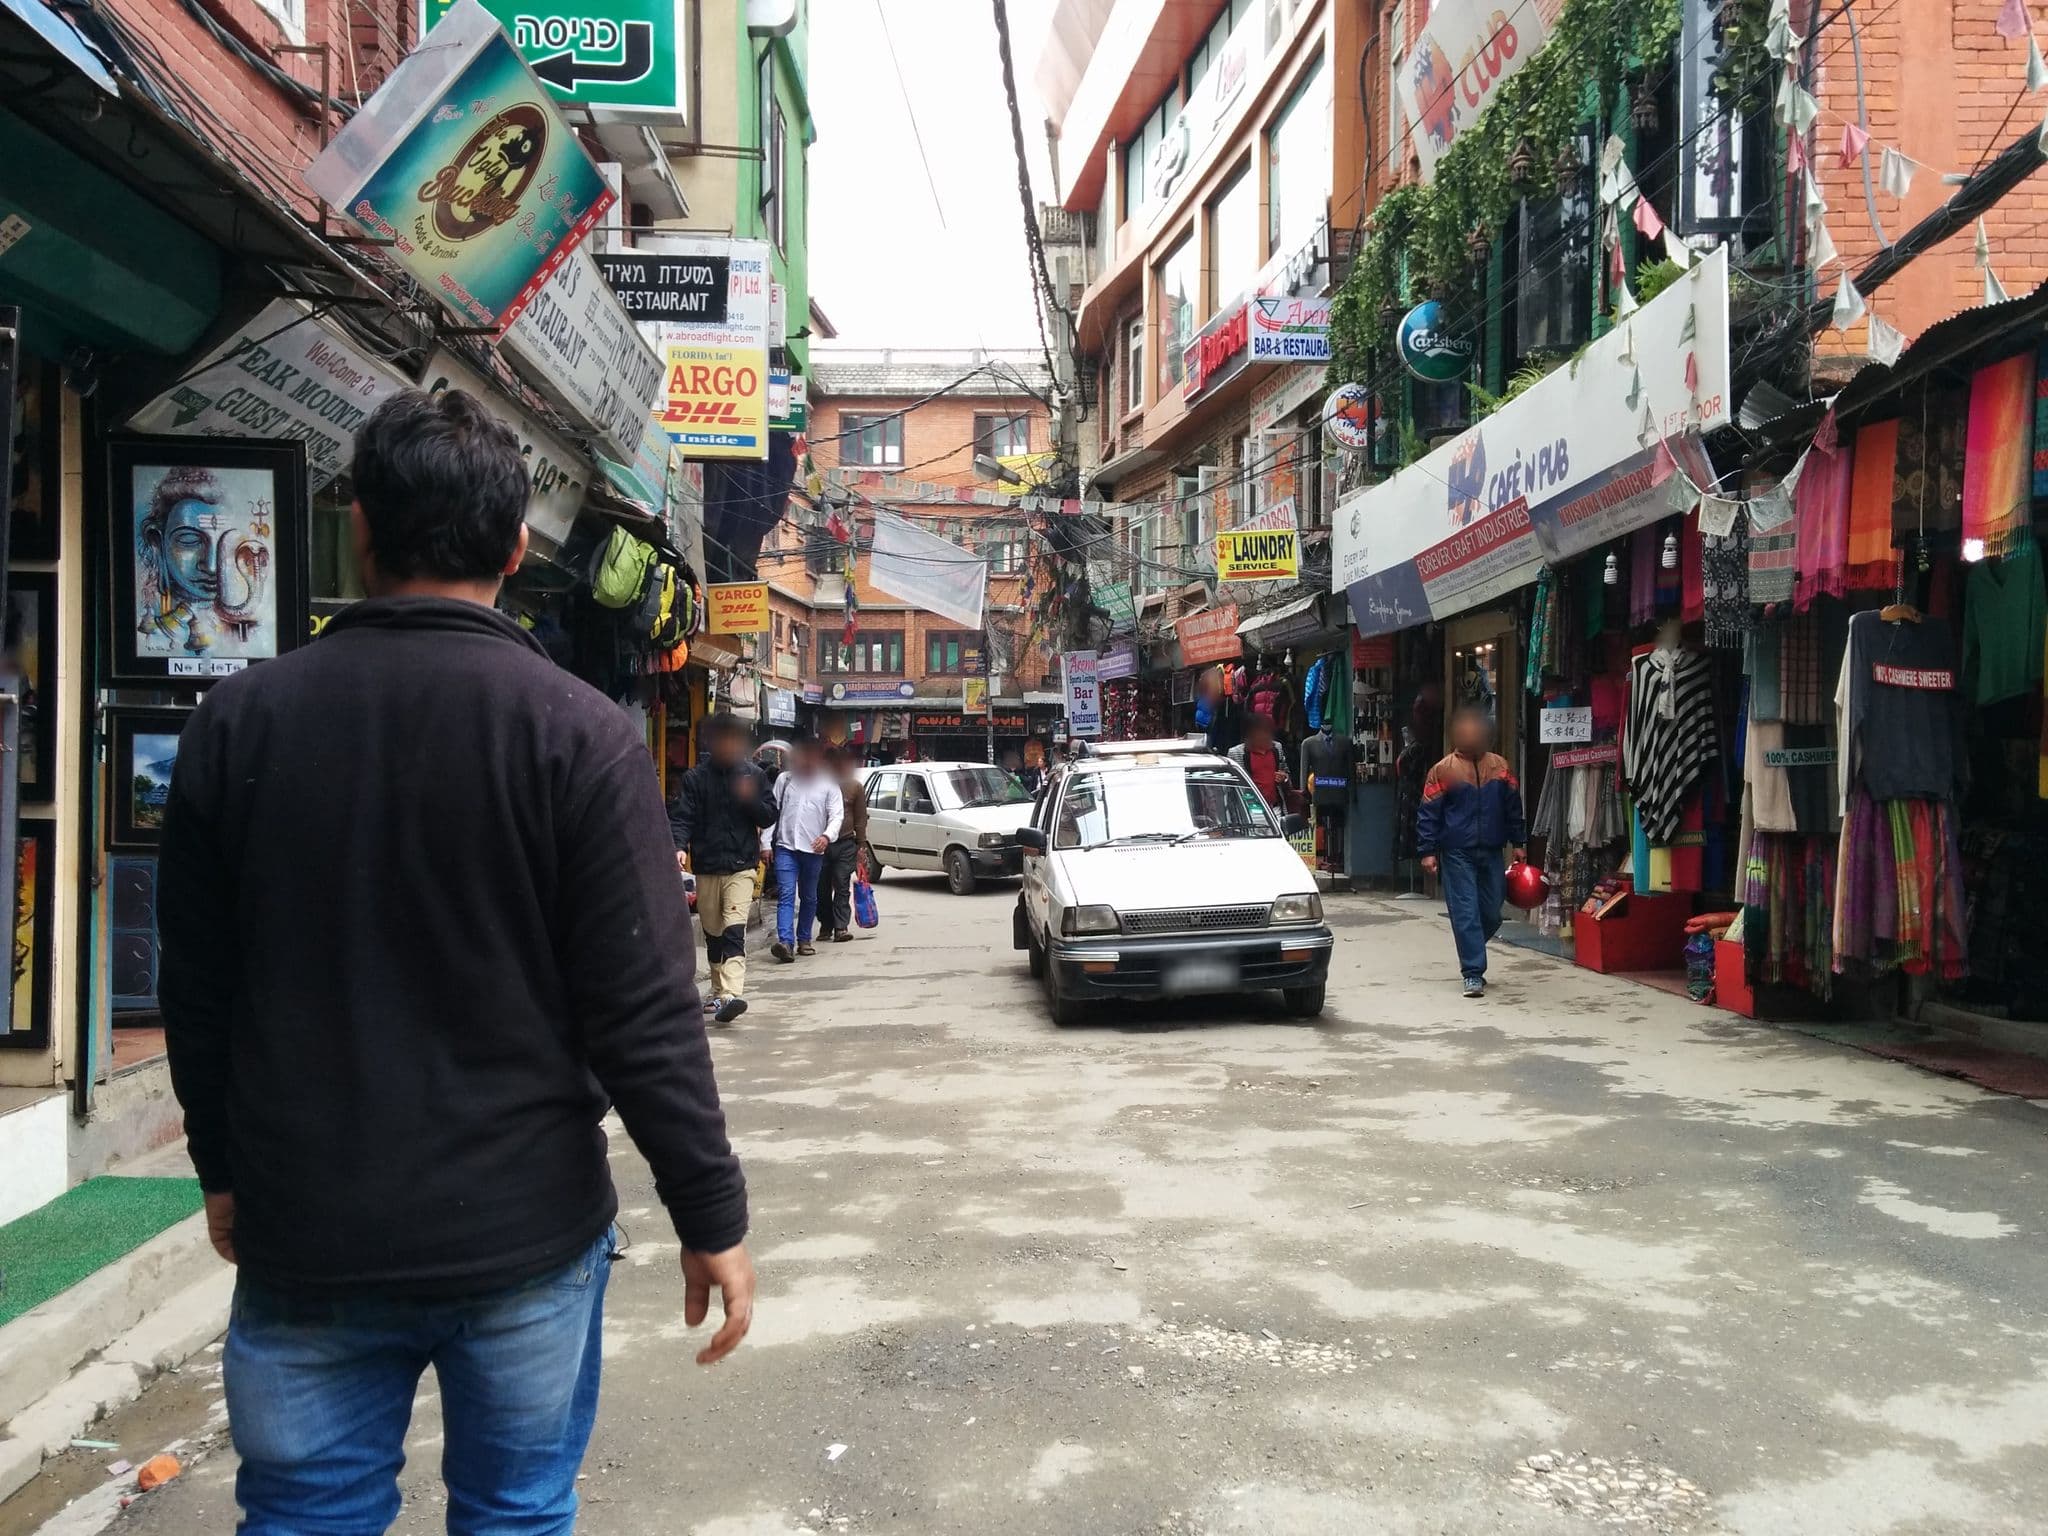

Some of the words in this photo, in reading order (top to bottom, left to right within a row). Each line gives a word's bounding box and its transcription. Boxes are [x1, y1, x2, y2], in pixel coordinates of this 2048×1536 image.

[516, 18, 618, 48] כניסה
[1460, 9, 1518, 108] CLUB
[483, 113, 510, 140] The
[467, 145, 504, 181] Ugly
[418, 165, 521, 226] Duckling
[414, 214, 428, 245] Foods
[422, 240, 433, 252] &
[430, 245, 460, 259] Drinks
[604, 264, 647, 284] מאיה
[658, 265, 714, 285] מסעדת
[729, 260, 762, 272] VENTURE
[744, 275, 762, 294] Ltd.
[617, 290, 710, 312] RESTAURANT
[1254, 336, 1272, 355] BAR
[1274, 337, 1281, 354] &
[1283, 338, 1331, 357] RESTAURA
[1408, 328, 1474, 355] Carlsberg
[222, 336, 301, 392] PEAK
[672, 349, 713, 361] FLORIDA
[304, 340, 363, 388] Wel-Come
[360, 375, 376, 397] To
[668, 364, 758, 397] ARGO
[215, 387, 293, 434] GUEST
[662, 401, 742, 425] DHL
[679, 434, 739, 445] Inside
[1524, 452, 1535, 494] N
[1538, 437, 1569, 491] PUB
[1232, 533, 1295, 562] LAUNDRY
[1416, 547, 1451, 577] FOREVER
[1450, 535, 1477, 561] CRAFT
[1476, 501, 1531, 548] INDUSTRIES
[1228, 561, 1278, 572] SERVICE
[1343, 551, 1359, 568] EVERY
[1358, 546, 1369, 564] DAY
[715, 588, 762, 600] CARGO
[720, 603, 757, 614] DHL
[1888, 667, 1918, 687] CASHMERE
[1918, 671, 1952, 689] SWEETER
[1073, 687, 1093, 699] Bar
[1080, 700, 1088, 710] &
[1071, 710, 1099, 725] Restaurant
[1555, 753, 1571, 766] 100%
[1570, 749, 1590, 763] Natural
[1590, 747, 1618, 760] Cashmere
[1765, 751, 1789, 764] 100%
[1291, 842, 1313, 853] VICE
